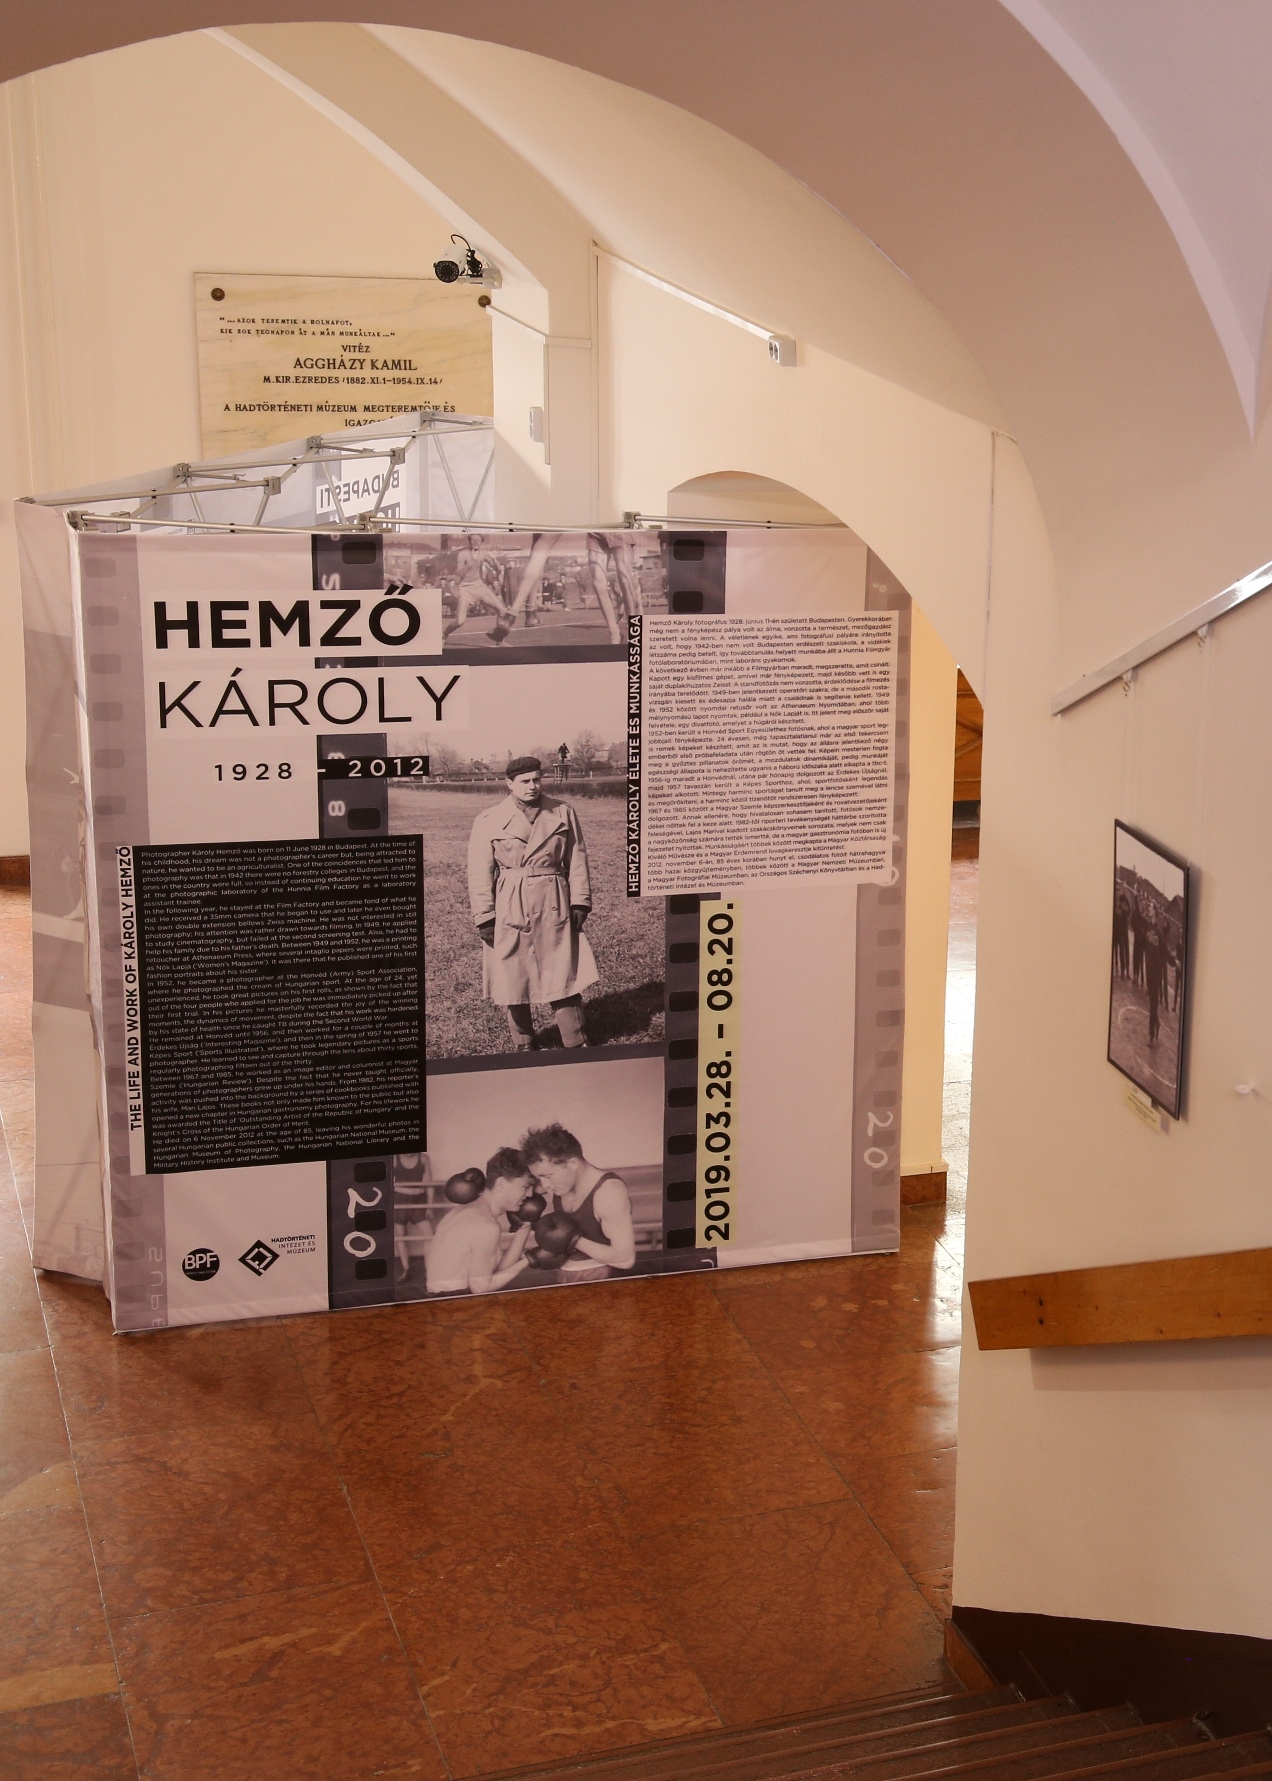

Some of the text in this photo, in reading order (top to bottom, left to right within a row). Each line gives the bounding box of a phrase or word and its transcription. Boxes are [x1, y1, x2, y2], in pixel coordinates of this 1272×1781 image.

[341, 342, 371, 353] VITÉZ
[293, 354, 418, 371] AGGHÁZY KAMIL
[223, 404, 231, 412] A
[235, 401, 313, 412] HADTÖRTÉNETI
[316, 401, 357, 412] MÚZEUM
[443, 401, 456, 412] ÉS
[153, 584, 421, 649] HEMZŐ
[672, 618, 693, 626] Károly
[694, 618, 727, 626] fotográfus
[745, 617, 763, 625] június
[846, 615, 892, 623] Gyerekkorában
[675, 642, 691, 650] hogy
[757, 640, 793, 648] Budapesten
[158, 667, 461, 729] KÁROLY
[648, 737, 671, 745] jobbjait
[769, 732, 817, 741] tapasztalatlanul
[626, 615, 641, 892] HEMZŐ KÁROLY ÉLETE ÉS MUNKÁSSÁGA
[214, 763, 293, 782] 1928
[348, 757, 424, 777] 2012
[141, 850, 190, 859] Photographer
[191, 849, 214, 857] Károly
[797, 860, 819, 868] Magyar
[169, 889, 217, 898] photographic
[221, 887, 257, 896] laboratory
[332, 883, 359, 891] Factory
[381, 880, 416, 889] laboratory
[706, 902, 734, 1012] 08.20.
[226, 974, 274, 984] photographer
[329, 970, 354, 978] (Army)
[356, 968, 375, 976] Sport
[115, 846, 142, 1131] THE LIFE AND WORK OF KÁROLY HEMZŐ
[153, 1152, 188, 1162] Hungarian
[192, 1150, 220, 1158] Museum
[298, 1141, 332, 1150] Hungarian
[335, 1138, 362, 1146] National
[366, 1136, 389, 1145] Library
[704, 1050, 733, 1242] 2019.03.28.
[153, 1161, 178, 1170] Military
[180, 1159, 204, 1168] History
[206, 1156, 234, 1164] Institute
[271, 1234, 316, 1243] HADTÖRTÉNETI
[278, 1240, 306, 1249] INTÉZET
[286, 1246, 316, 1254] MÚZEUM
[184, 1253, 218, 1270] BPF
